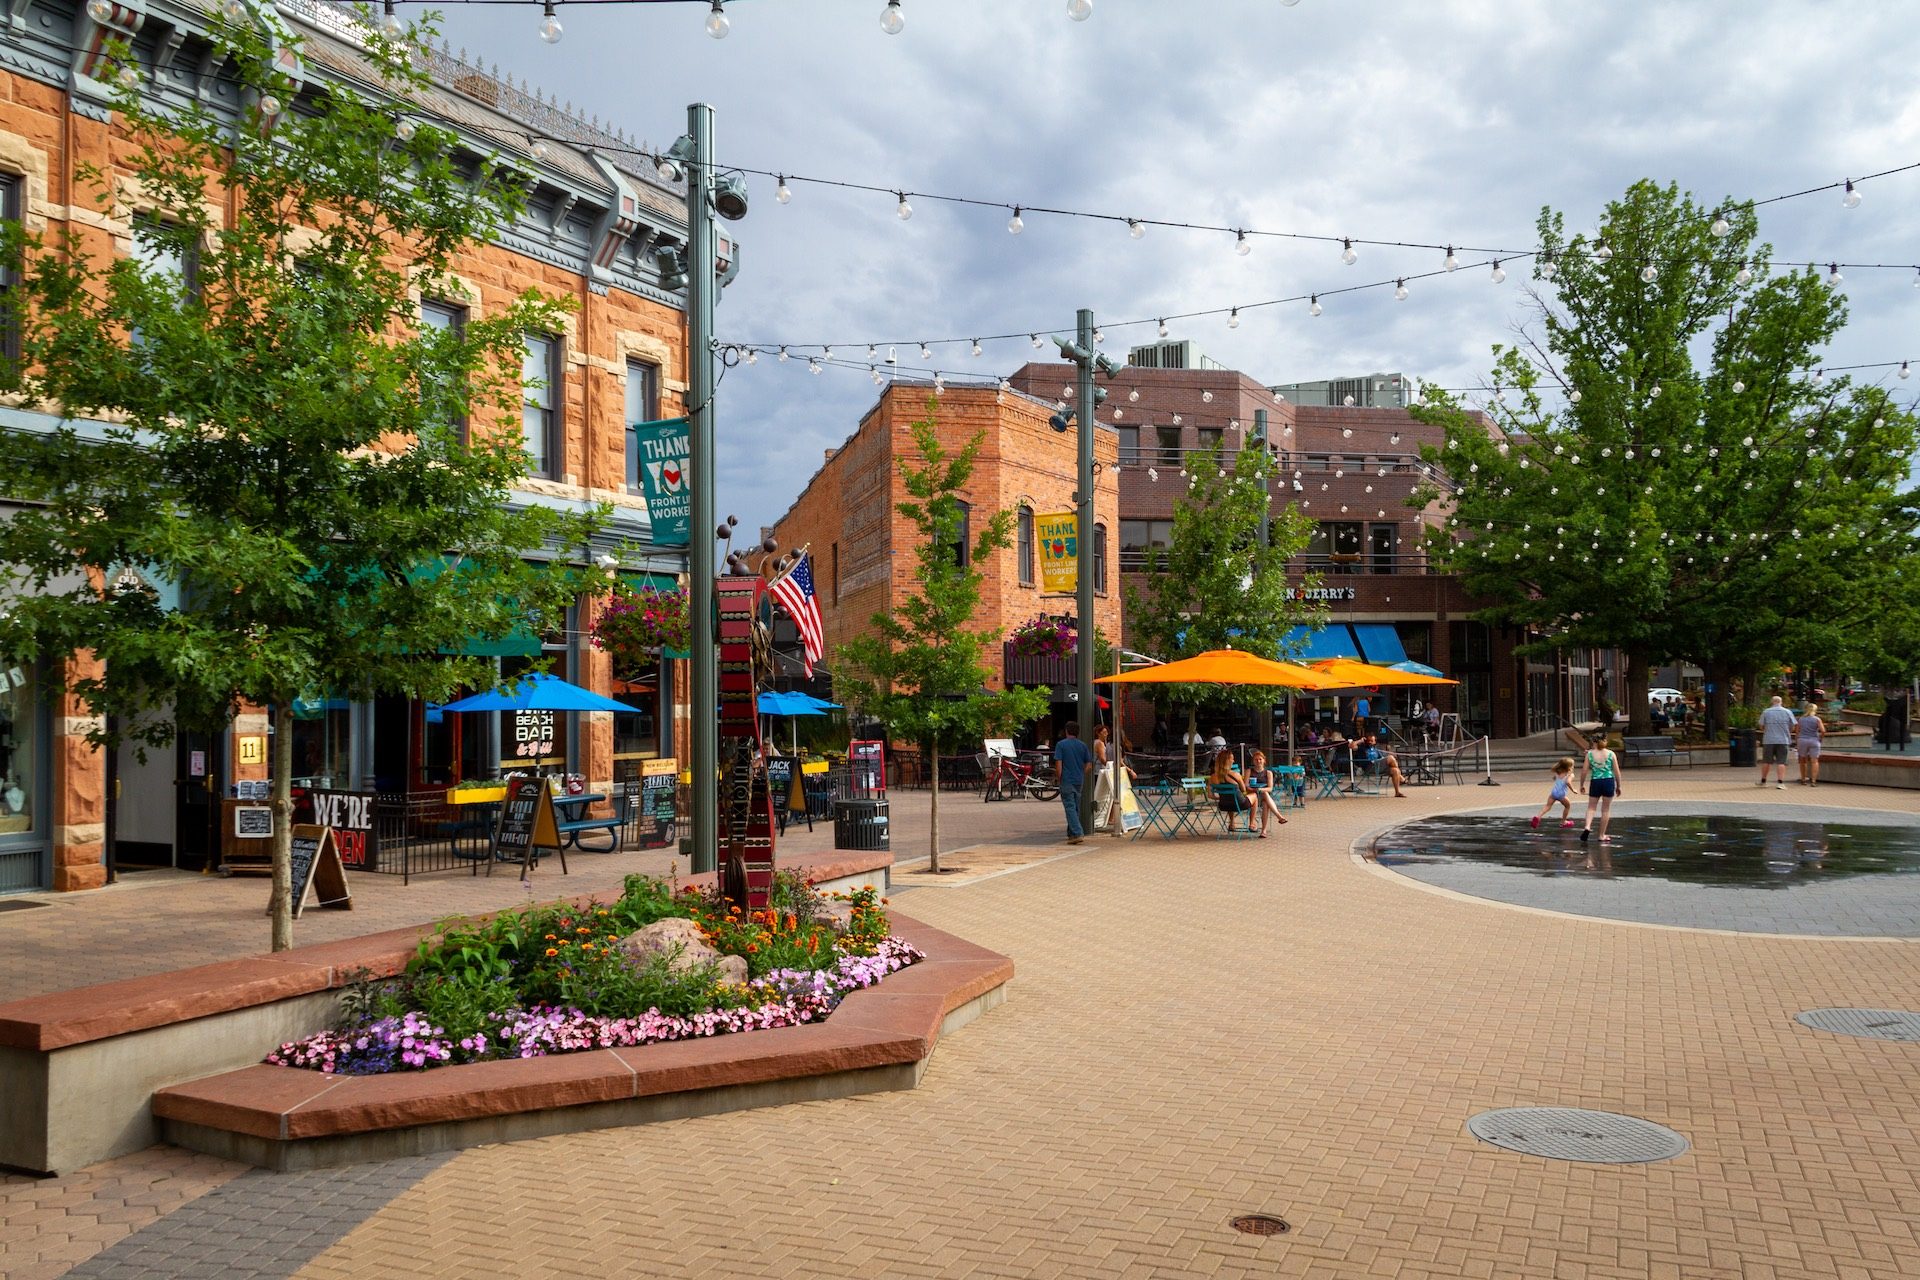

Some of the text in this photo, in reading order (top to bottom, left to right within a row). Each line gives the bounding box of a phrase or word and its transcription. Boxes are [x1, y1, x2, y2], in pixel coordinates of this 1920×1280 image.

[650, 496, 680, 508] FRONT
[652, 505, 690, 519] WORKE
[1040, 523, 1075, 536] THANK
[1042, 537, 1076, 559] YOU
[118, 575, 139, 585] OLD
[1305, 586, 1355, 600] JERRY'S
[516, 715, 554, 726] BEACH
[516, 726, 554, 741] BAR
[242, 742, 256, 759] 11
[528, 741, 553, 757] Gill
[768, 760, 791, 770] JACK
[313, 792, 373, 830] WE'RE
